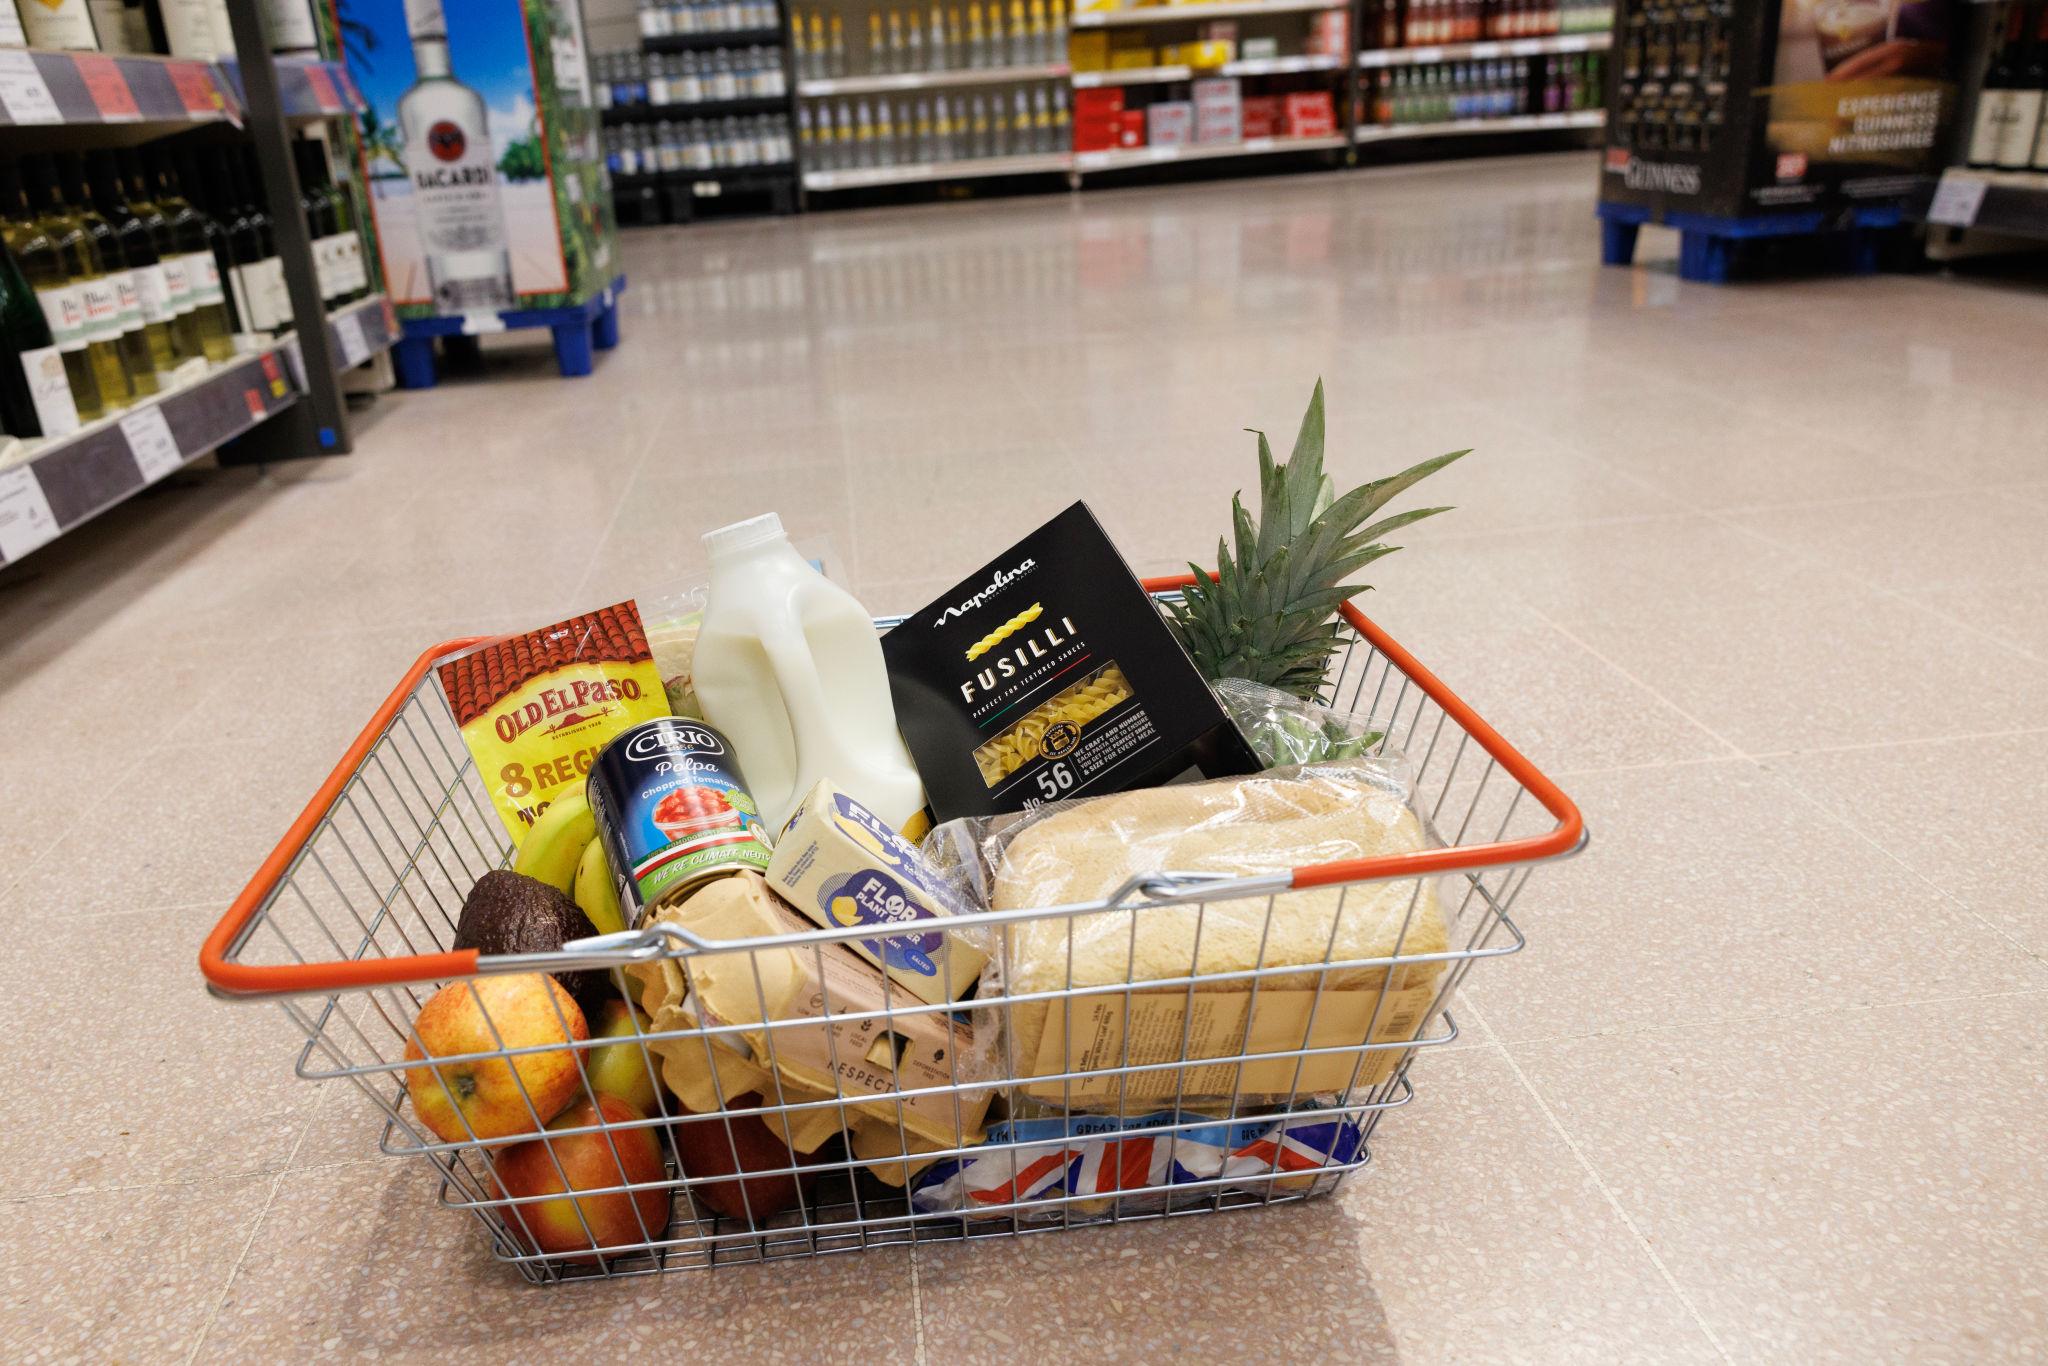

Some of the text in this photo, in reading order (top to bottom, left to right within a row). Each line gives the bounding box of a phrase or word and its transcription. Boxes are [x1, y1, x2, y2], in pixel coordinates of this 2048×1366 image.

[1837, 88, 1941, 117] EXPERIENCE
[1853, 112, 1938, 134] GUINNESS
[1625, 157, 1700, 194] GUINNESS
[960, 616, 1078, 704] FUSILLI
[972, 641, 1086, 718] PERFECT FOR TEXTURED SAUCES
[495, 702, 543, 743] OLD
[538, 688, 577, 718] EL
[635, 731, 715, 753] CIRIO
[1073, 746, 1086, 758] WE
[1084, 735, 1105, 750] CRAFT
[1105, 726, 1119, 739] AND
[1118, 710, 1146, 729] NUMBER
[1077, 751, 1093, 764] EACH
[1091, 741, 1110, 756] PASTA
[1109, 734, 1120, 744] DIE
[1119, 729, 1127, 737] TO
[1127, 716, 1149, 732] ENSURE
[1080, 722, 1153, 769] YOU GET THE PERFECT SHAPE
[1089, 760, 1105, 772] SIZE
[1104, 751, 1118, 763] FOR
[1117, 739, 1139, 754] EVERY
[1138, 727, 1157, 742] MEAL
[500, 762, 533, 797] 8
[655, 758, 719, 776] Polpa
[642, 776, 740, 799] Chopped Tomatoes
[1022, 797, 1044, 812] No.
[1036, 762, 1073, 799] 56
[654, 858, 689, 884] WE'RE
[855, 891, 888, 917] PLANT
[911, 955, 930, 971] SALTED
